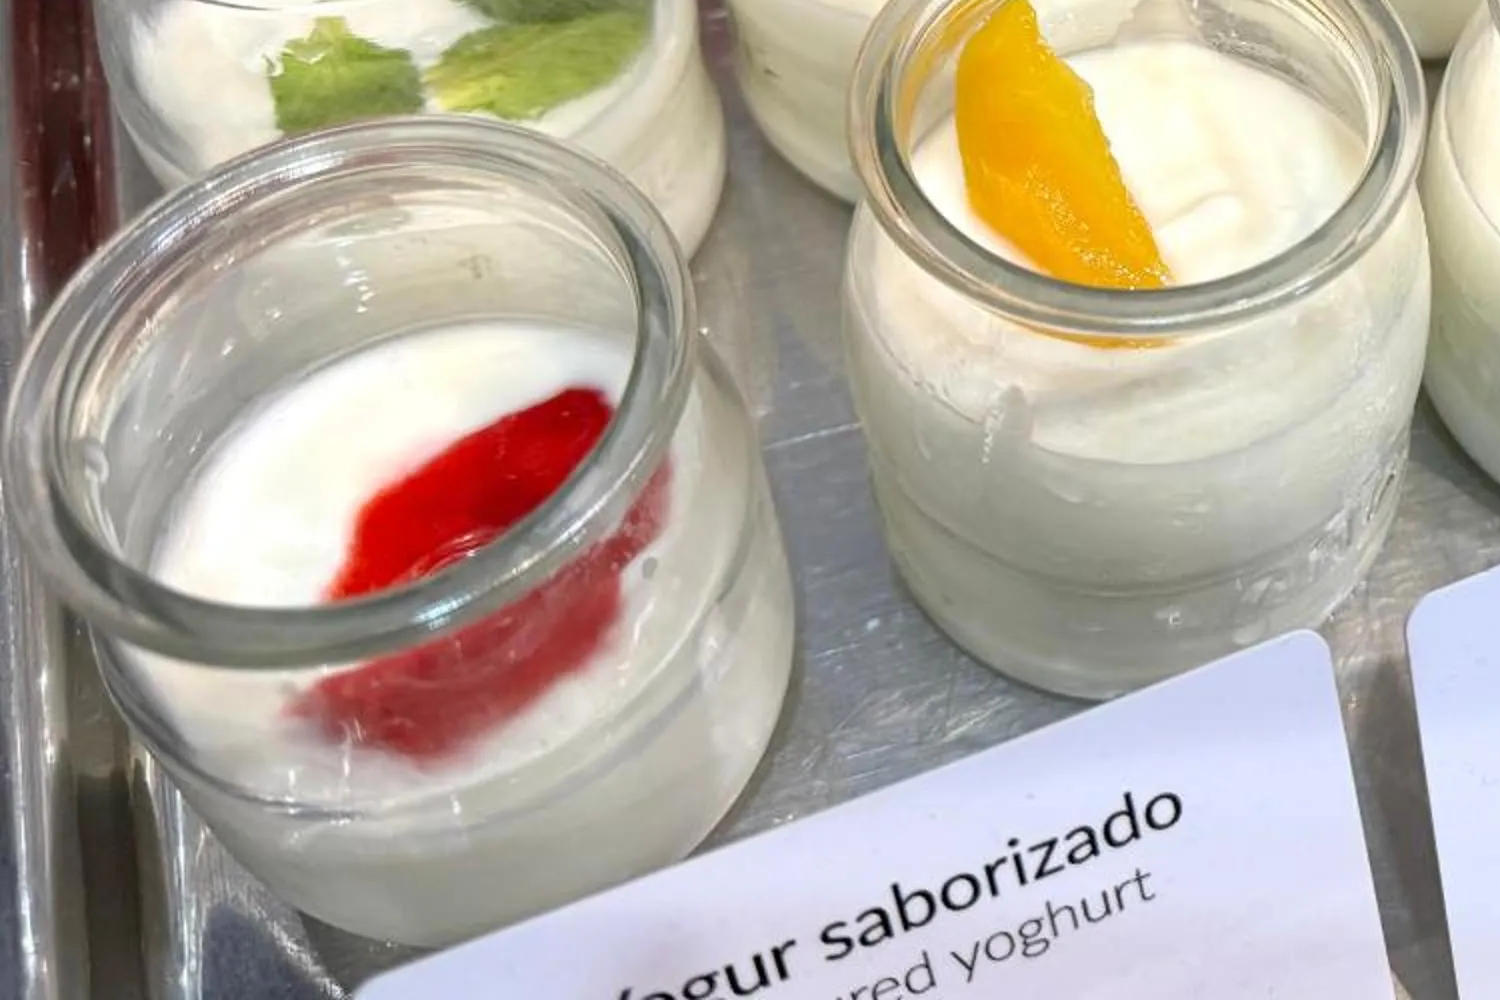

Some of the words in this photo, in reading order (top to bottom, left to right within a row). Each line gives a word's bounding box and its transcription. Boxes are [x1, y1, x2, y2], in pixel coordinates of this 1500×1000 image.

[617, 939, 797, 1000] gur
[820, 791, 1183, 961] saborizado
[951, 867, 1156, 983] yoghurt
